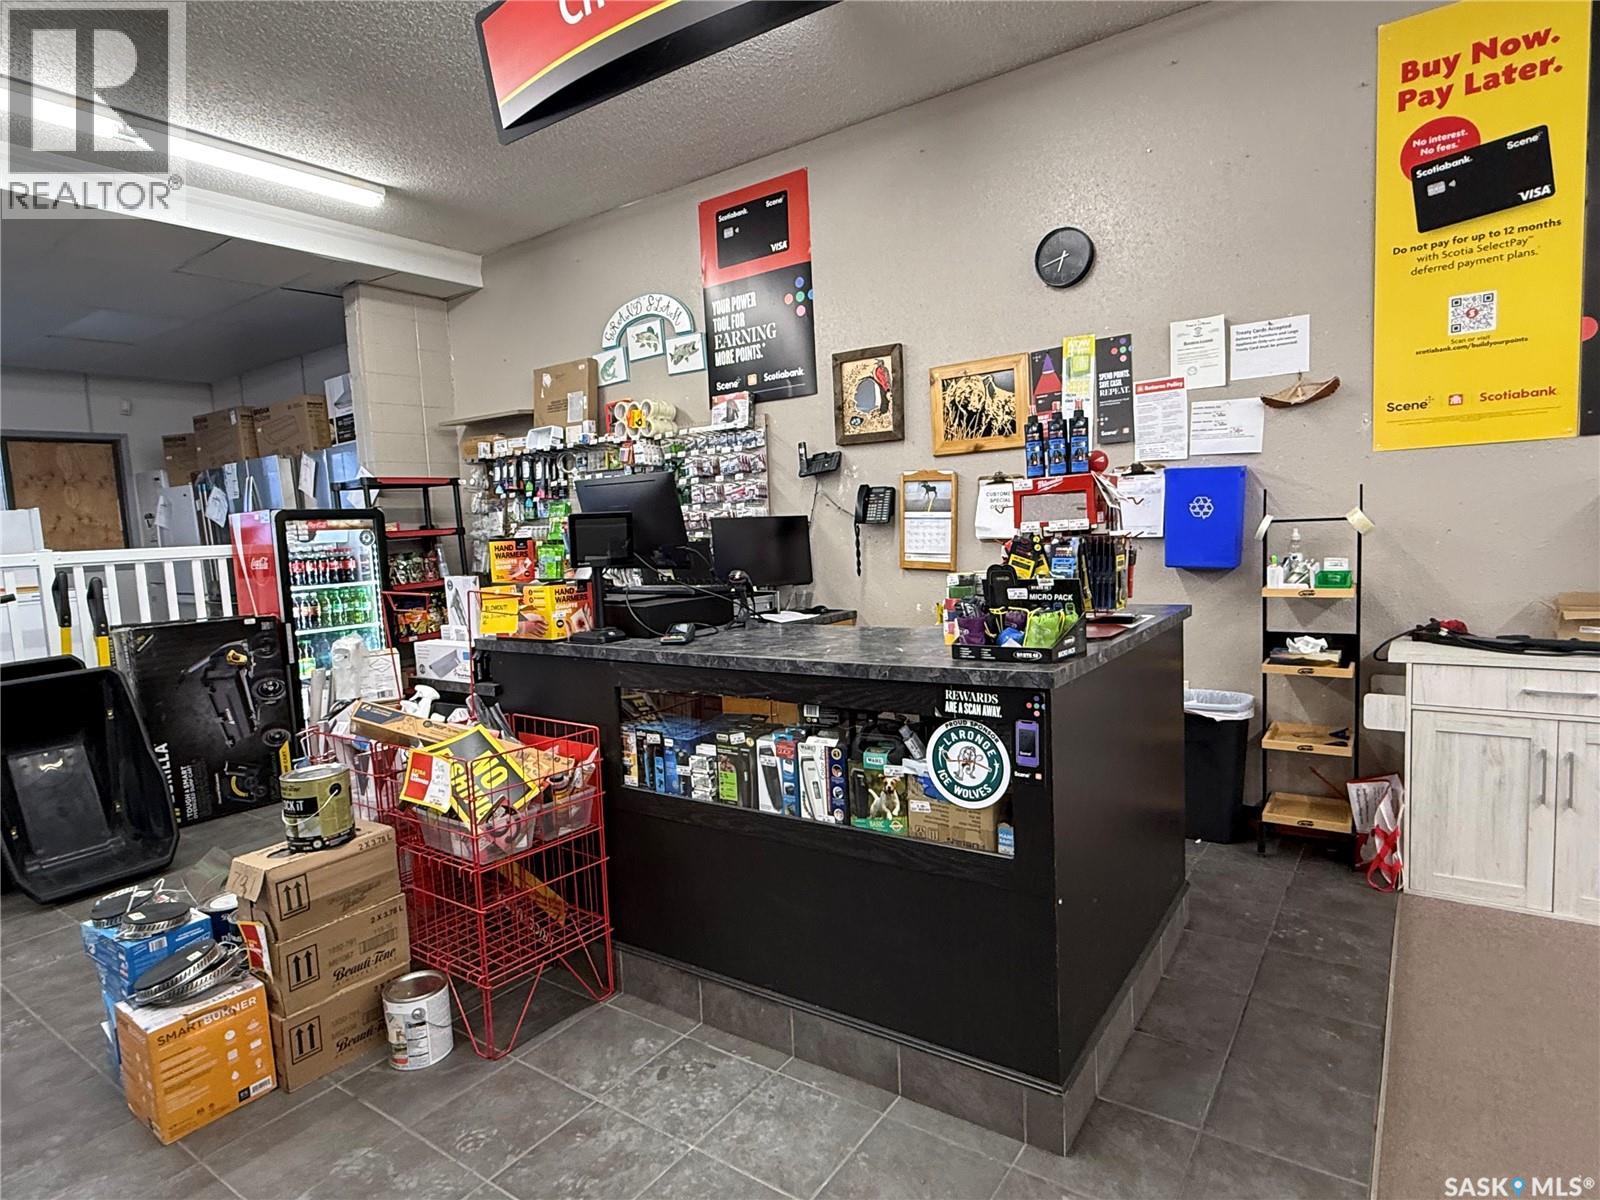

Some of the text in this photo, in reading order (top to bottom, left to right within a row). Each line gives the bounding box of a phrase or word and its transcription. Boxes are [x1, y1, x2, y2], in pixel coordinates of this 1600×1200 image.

[1401, 27, 1561, 84] Buy Now.
[1397, 56, 1563, 112] Pay Later.
[1412, 129, 1469, 149] No interest.
[1420, 146, 1435, 157] No
[1518, 184, 1552, 201] VISA
[1393, 218, 1562, 255] Do not pay for up to 12 months
[770, 240, 787, 252] VISA
[1416, 250, 1439, 263] with
[1441, 245, 1474, 259] Scotia
[1410, 261, 1455, 276] deferred
[1457, 255, 1504, 270] payment
[712, 292, 757, 316] YOUR POWER
[713, 312, 745, 334] TOOL FOR
[714, 322, 777, 350] EARNING
[715, 348, 735, 367] MORE
[1479, 386, 1557, 402] Scotiabank
[494, 544, 514, 552] HAND
[494, 550, 529, 559] WARMERS
[555, 593, 588, 603] WARMERS
[1029, 593, 1074, 601] MICRO PACK
[945, 689, 999, 704] REWARDS
[945, 701, 1002, 718] ARE A SCAN AWAY.
[945, 720, 1000, 744] PROUD SPONSOR
[473, 750, 508, 789] NO
[938, 769, 992, 799] ICE WOLVES
[372, 837, 386, 846] 3.78
